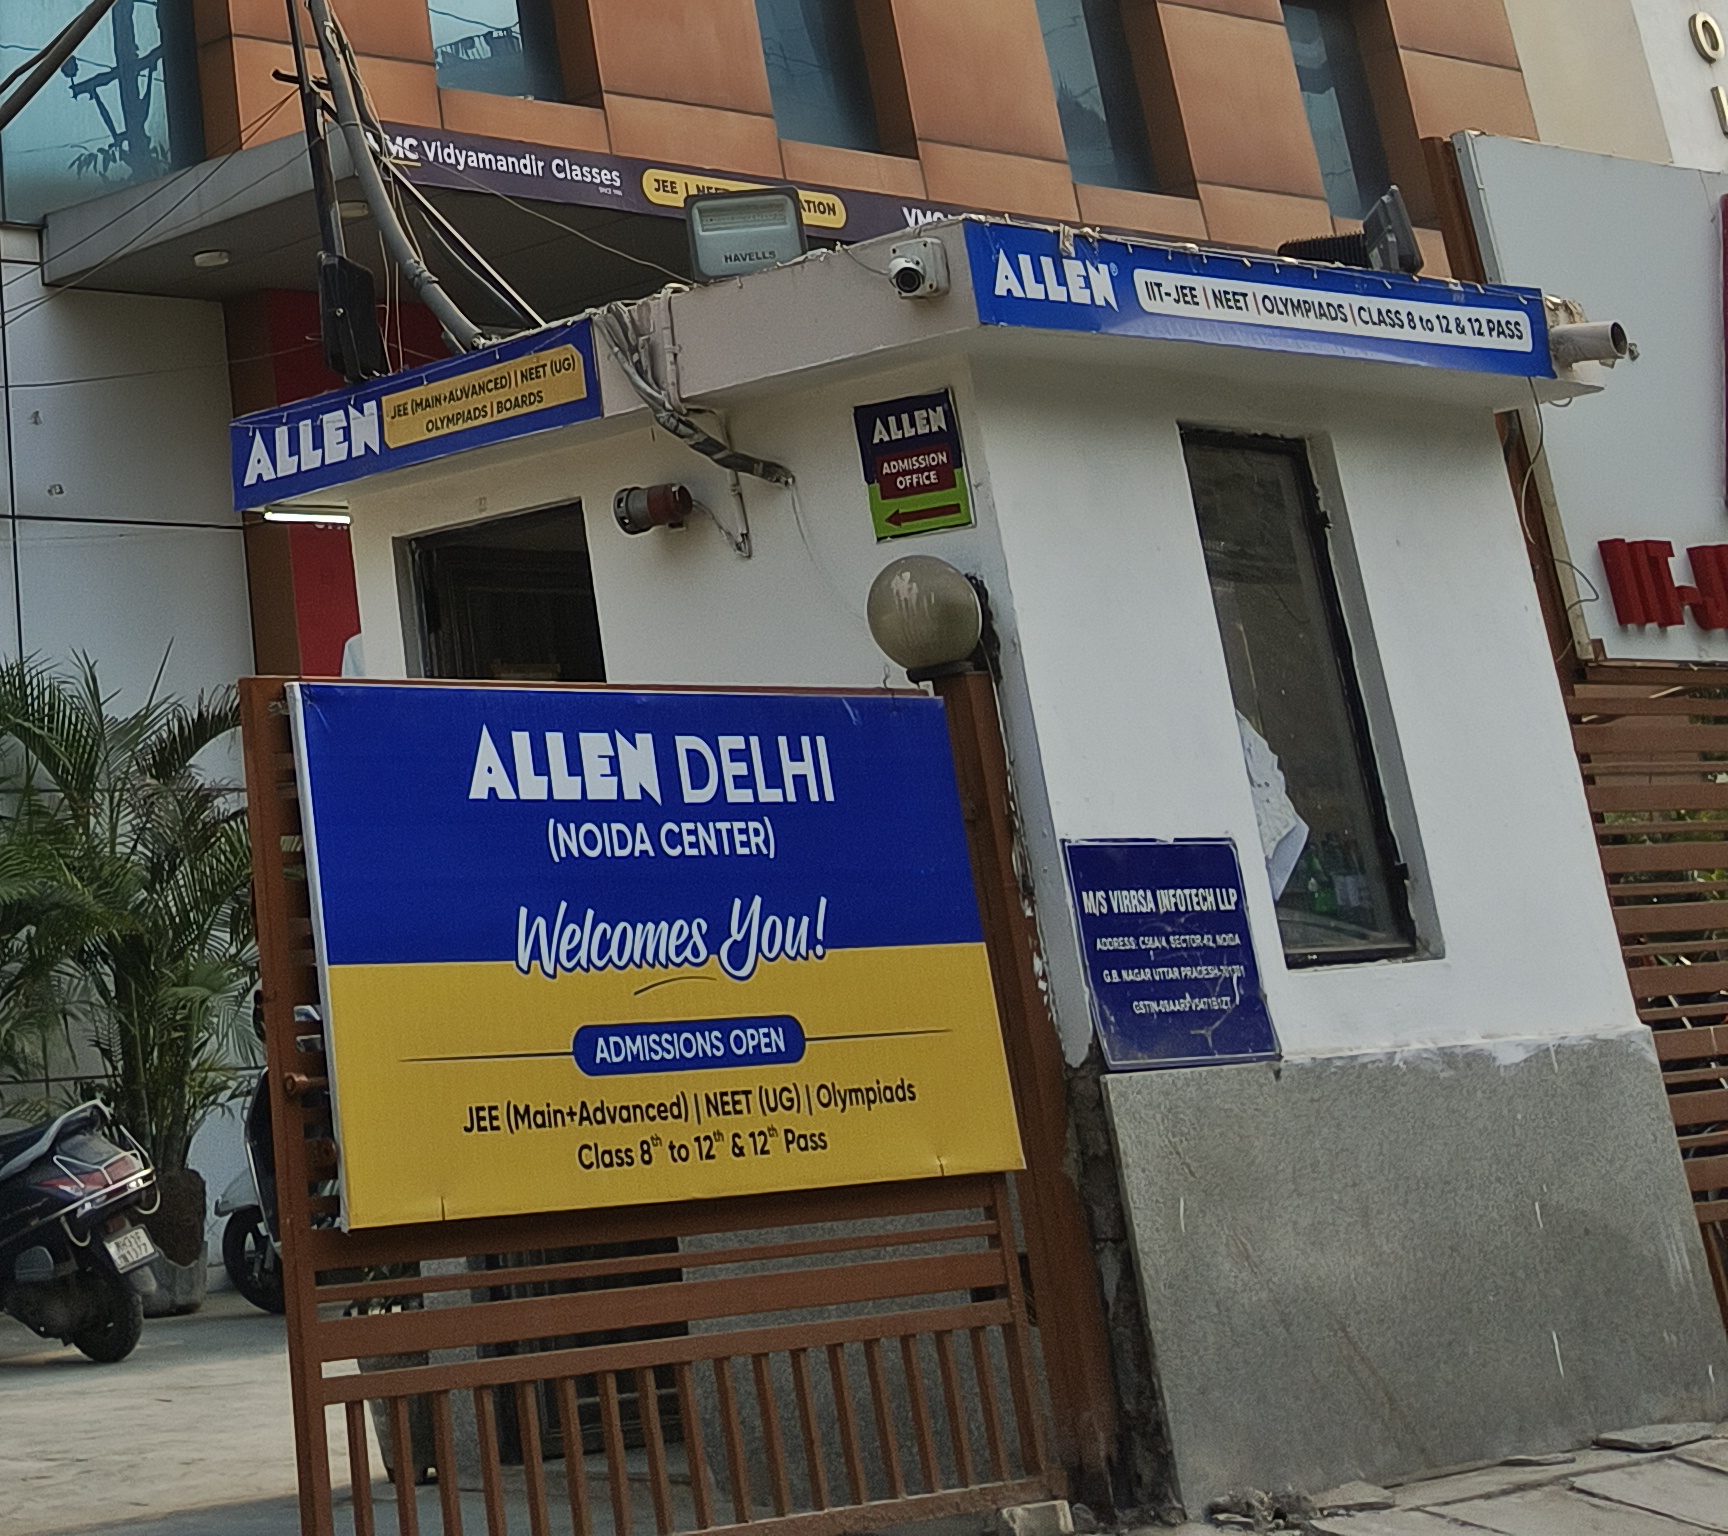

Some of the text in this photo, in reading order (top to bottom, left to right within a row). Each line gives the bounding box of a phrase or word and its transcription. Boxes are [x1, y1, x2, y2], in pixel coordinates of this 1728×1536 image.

[422, 140, 545, 177] Vidyamandir
[551, 158, 622, 187] Classes
[653, 178, 678, 195] JEE
[724, 250, 776, 264] HAVELLS
[994, 248, 1523, 340] ALLEN IIT-JEE NEET OLYMPIADS CLASS 8 to 12 & 12 PASS
[243, 353, 576, 487] ALLEN JEE (MAIN+ADVANCED) NEET (UG)
[426, 390, 544, 433] OLYMPIADS BOARDS
[873, 406, 947, 444] ALLEN
[882, 451, 948, 475] ADMISSION
[896, 471, 939, 490] OFFICE
[468, 723, 835, 806] ALLEN DELHI
[548, 816, 776, 862] (NOIDA CENTER)
[1082, 888, 1238, 916] M/S VIRRSA INFOTECH LLP
[517, 895, 827, 978] Welcomes You!
[1121, 968, 1152, 981] NAGAR
[1153, 967, 1181, 981] UTTAR
[595, 1027, 785, 1064] ADMISSIONS OPEN
[463, 1078, 917, 1133] JEE (Main+Advanced) NEET (UG) Olympiads
[577, 1143, 635, 1171] Class
[669, 1139, 690, 1163] to
[730, 1133, 745, 1158] &
[784, 1128, 828, 1153] Pass
